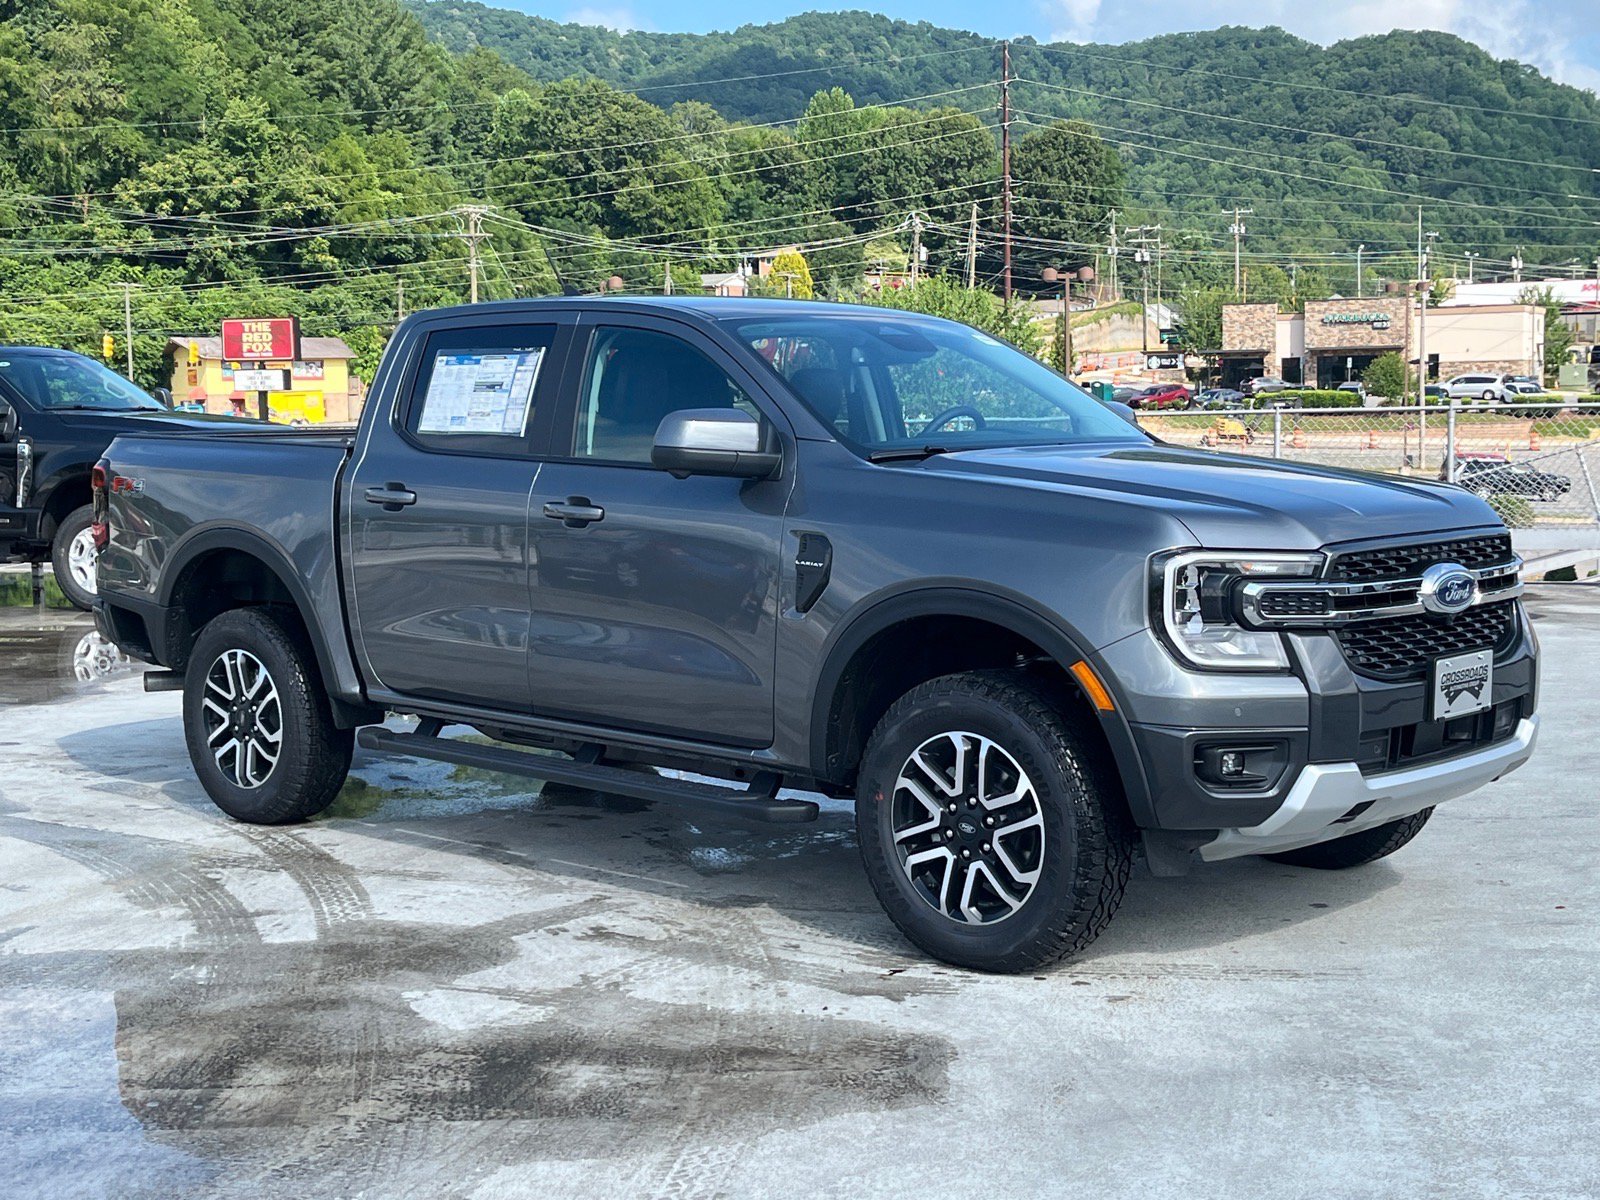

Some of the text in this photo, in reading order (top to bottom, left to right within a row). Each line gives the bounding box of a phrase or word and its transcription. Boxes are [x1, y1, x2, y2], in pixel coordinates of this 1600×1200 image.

[1323, 312, 1390, 323] STARBUCKS
[242, 321, 271, 332] THE
[242, 332, 273, 342] RED
[242, 342, 273, 352] FOX
[113, 476, 146, 494] FX4
[1445, 580, 1470, 602] Ford
[1440, 664, 1489, 685] CROSSROADS
